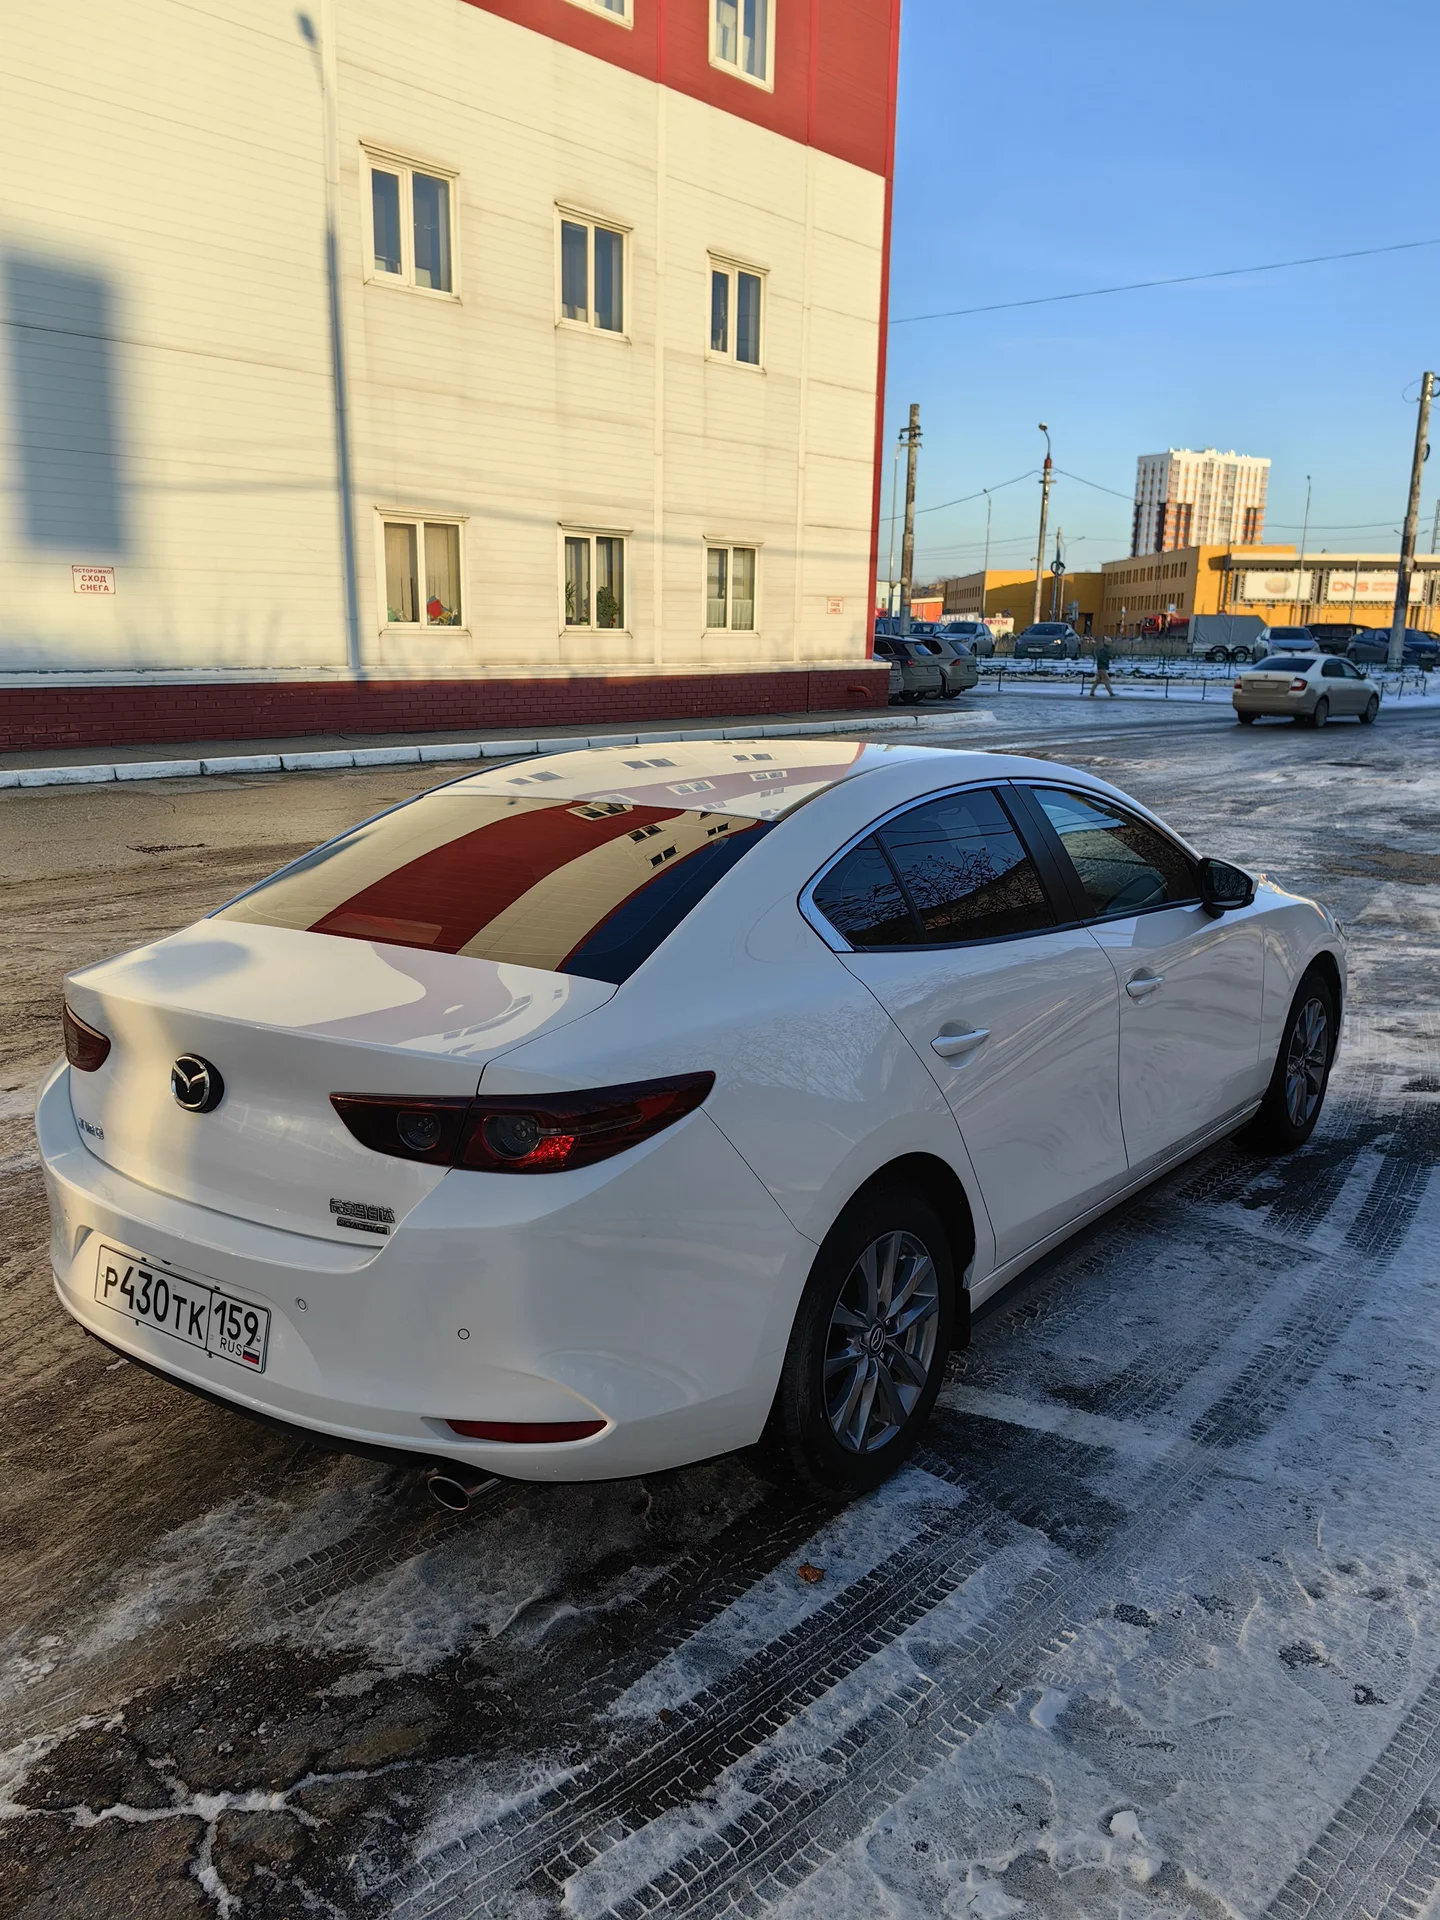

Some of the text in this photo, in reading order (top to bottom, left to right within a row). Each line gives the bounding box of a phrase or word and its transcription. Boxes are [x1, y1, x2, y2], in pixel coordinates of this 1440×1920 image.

[81, 575, 107, 583] СХОД
[80, 584, 110, 592] СНЕГА
[1332, 581, 1369, 592] DNS
[103, 1266, 259, 1347] Р430ТК 159
[219, 1337, 242, 1357] RUS
